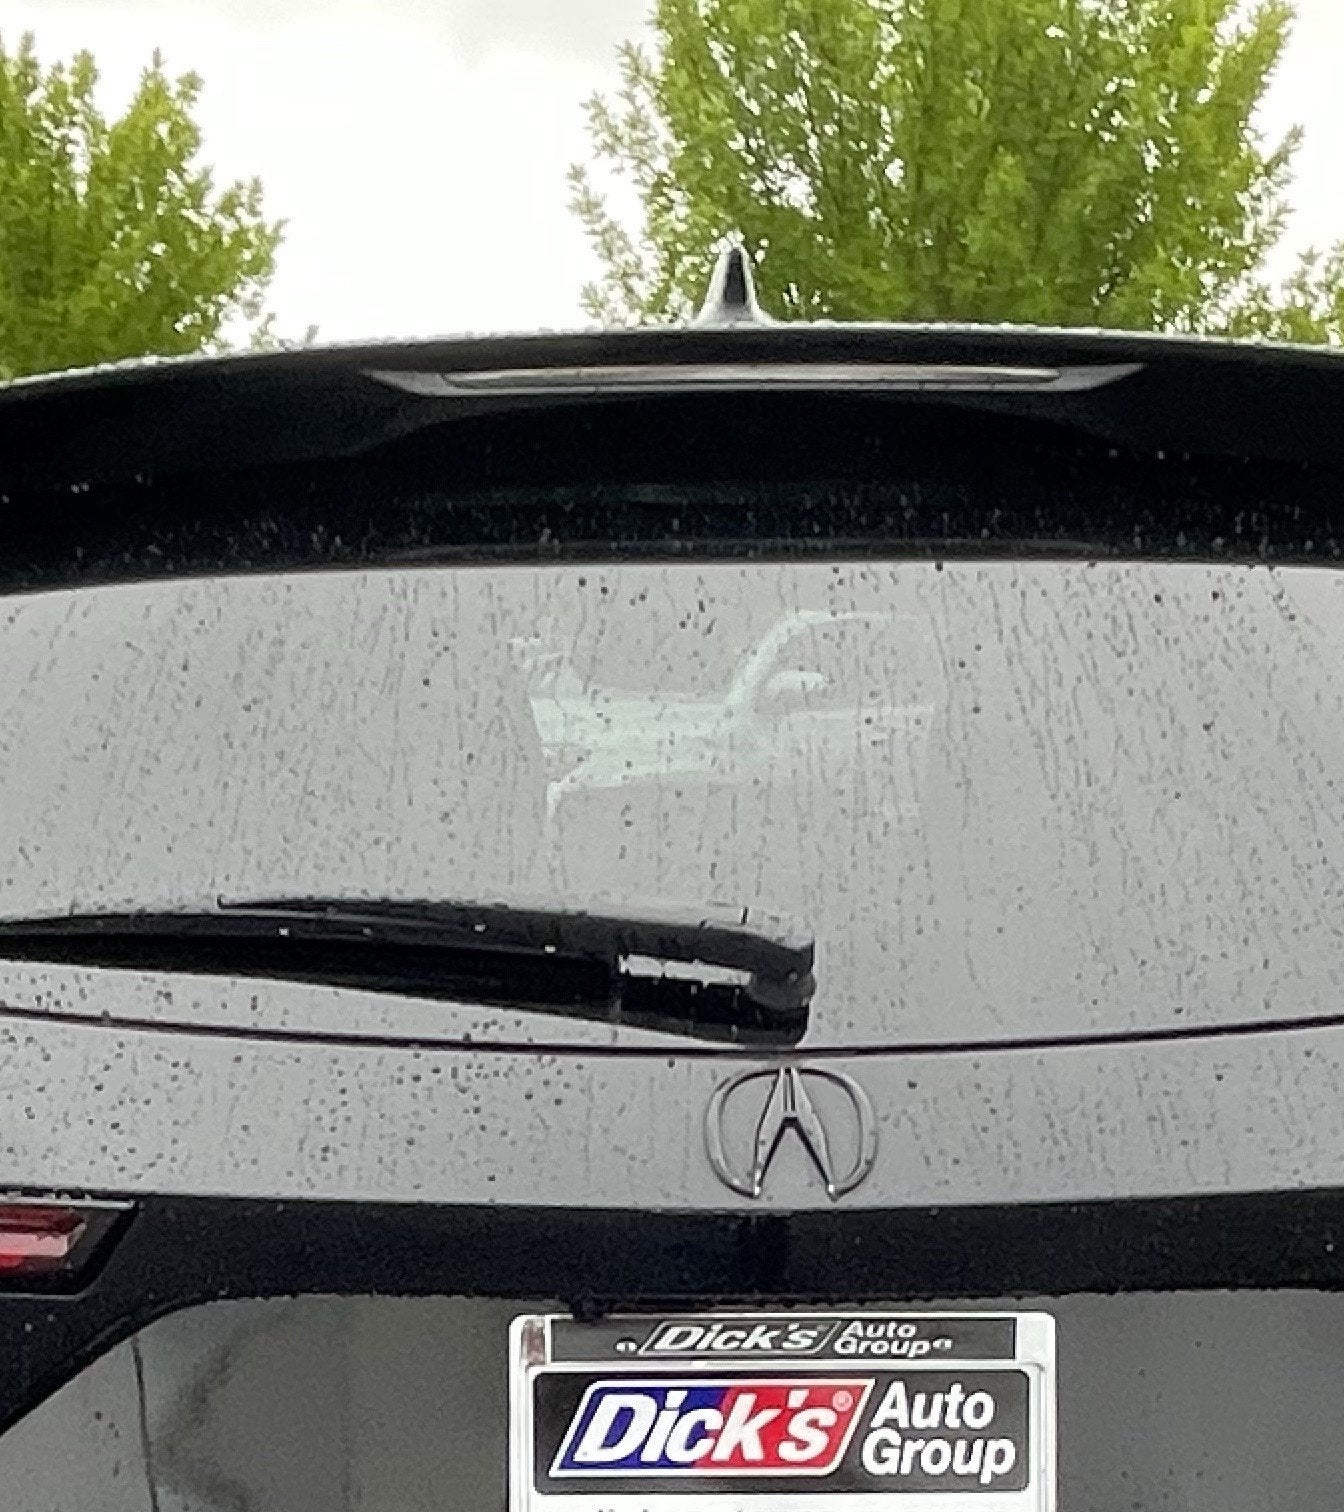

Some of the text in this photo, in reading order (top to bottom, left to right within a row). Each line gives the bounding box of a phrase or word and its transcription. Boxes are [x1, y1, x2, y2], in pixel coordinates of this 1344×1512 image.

[841, 1321, 917, 1339] Auto
[833, 1337, 931, 1358] Group
[870, 1381, 995, 1429] Auto
[861, 1430, 1017, 1484] Group
